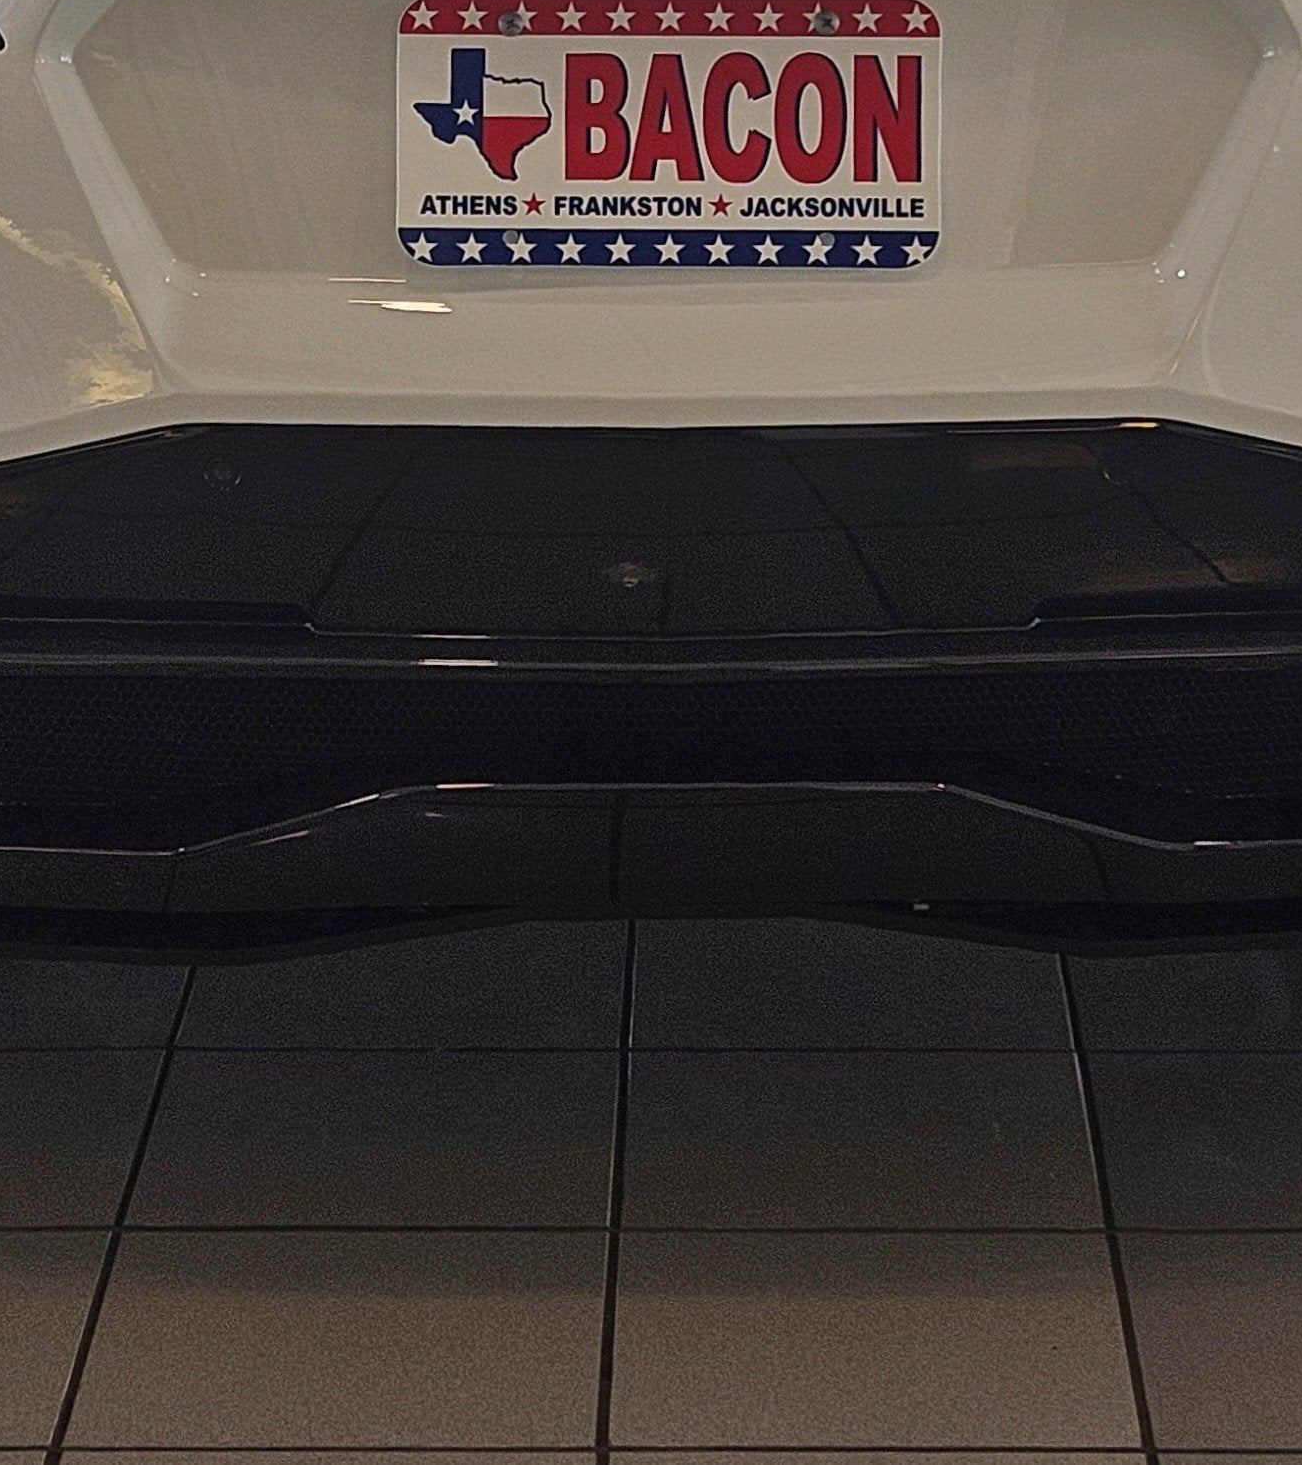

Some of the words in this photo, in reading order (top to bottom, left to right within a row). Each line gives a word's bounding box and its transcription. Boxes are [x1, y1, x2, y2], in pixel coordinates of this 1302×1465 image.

[564, 51, 924, 185] BACON
[419, 194, 518, 218] ATHENS
[553, 195, 703, 219] FRANKSTON
[739, 196, 926, 220] JACKSONVILLE
